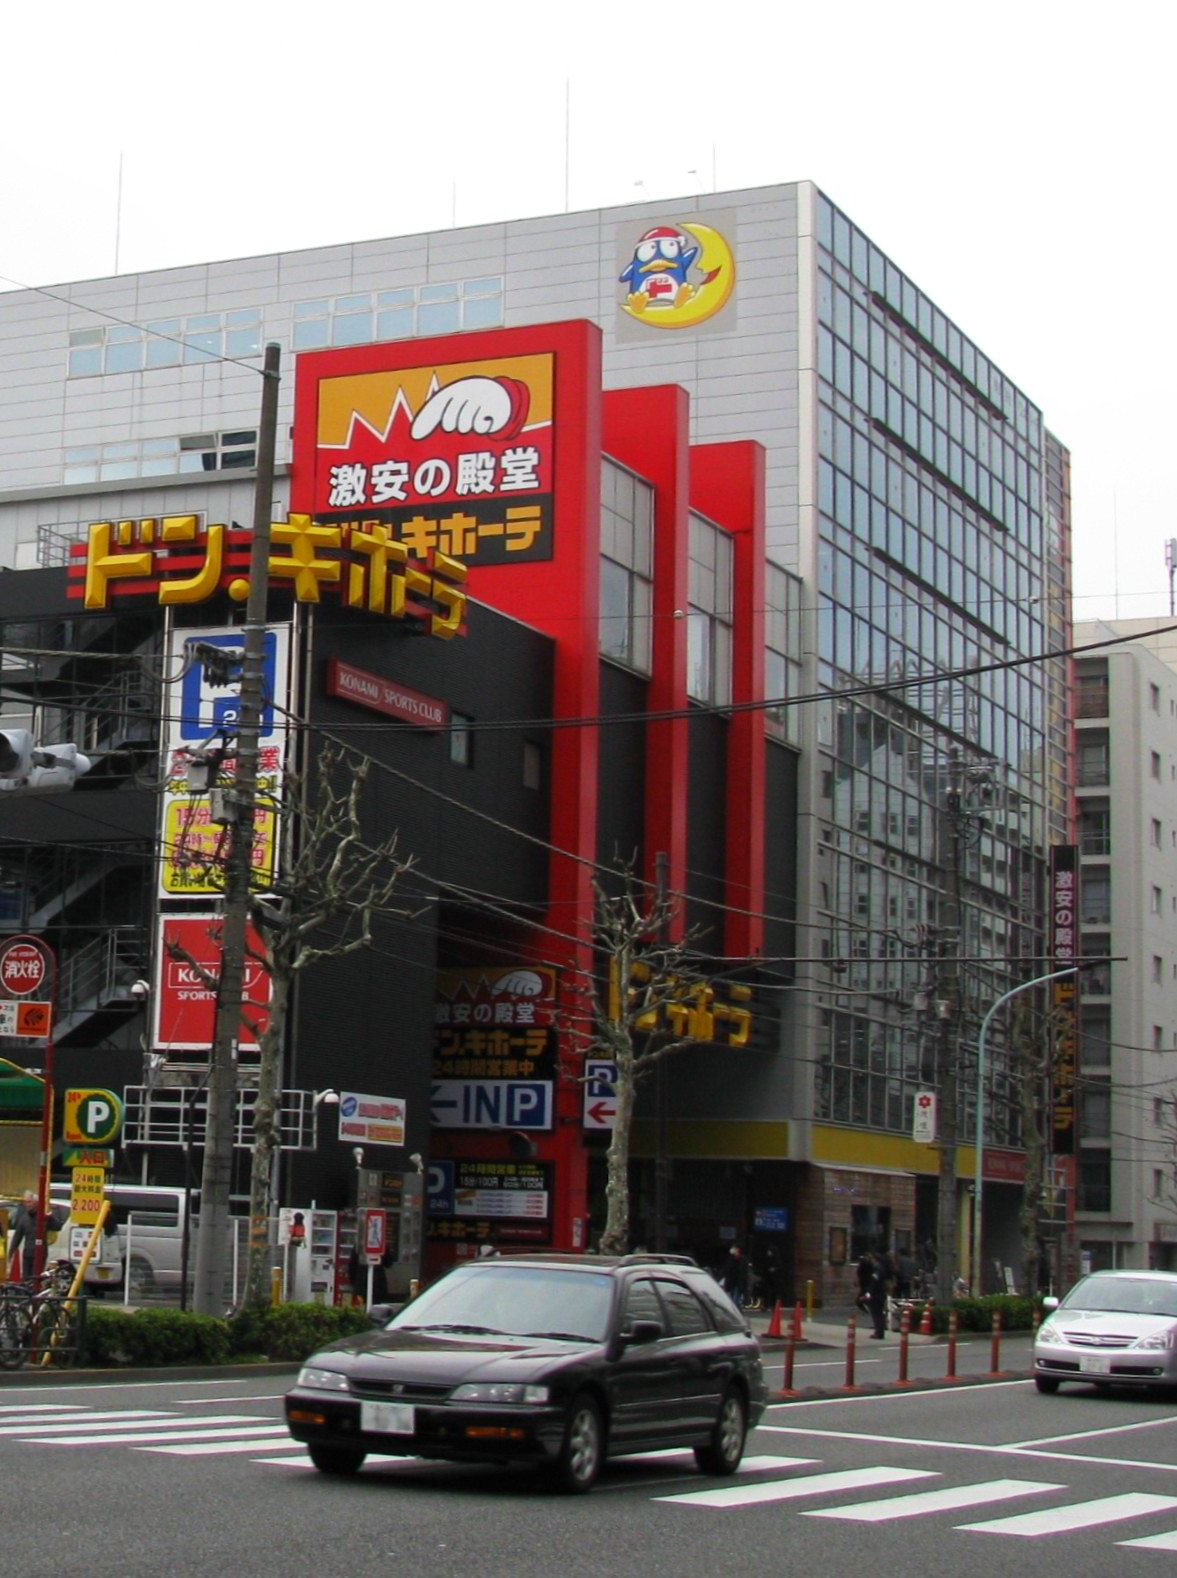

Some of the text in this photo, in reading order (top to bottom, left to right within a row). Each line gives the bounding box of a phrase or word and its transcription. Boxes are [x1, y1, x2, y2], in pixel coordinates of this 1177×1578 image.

[328, 446, 540, 507] 激安の殿堂
[339, 671, 442, 723] KONAMI SPORTS CLUB
[4, 960, 41, 979] 消火栓
[87, 1101, 110, 1134] P
[463, 1085, 538, 1124] IN P
[79, 1150, 105, 1164] 入口
